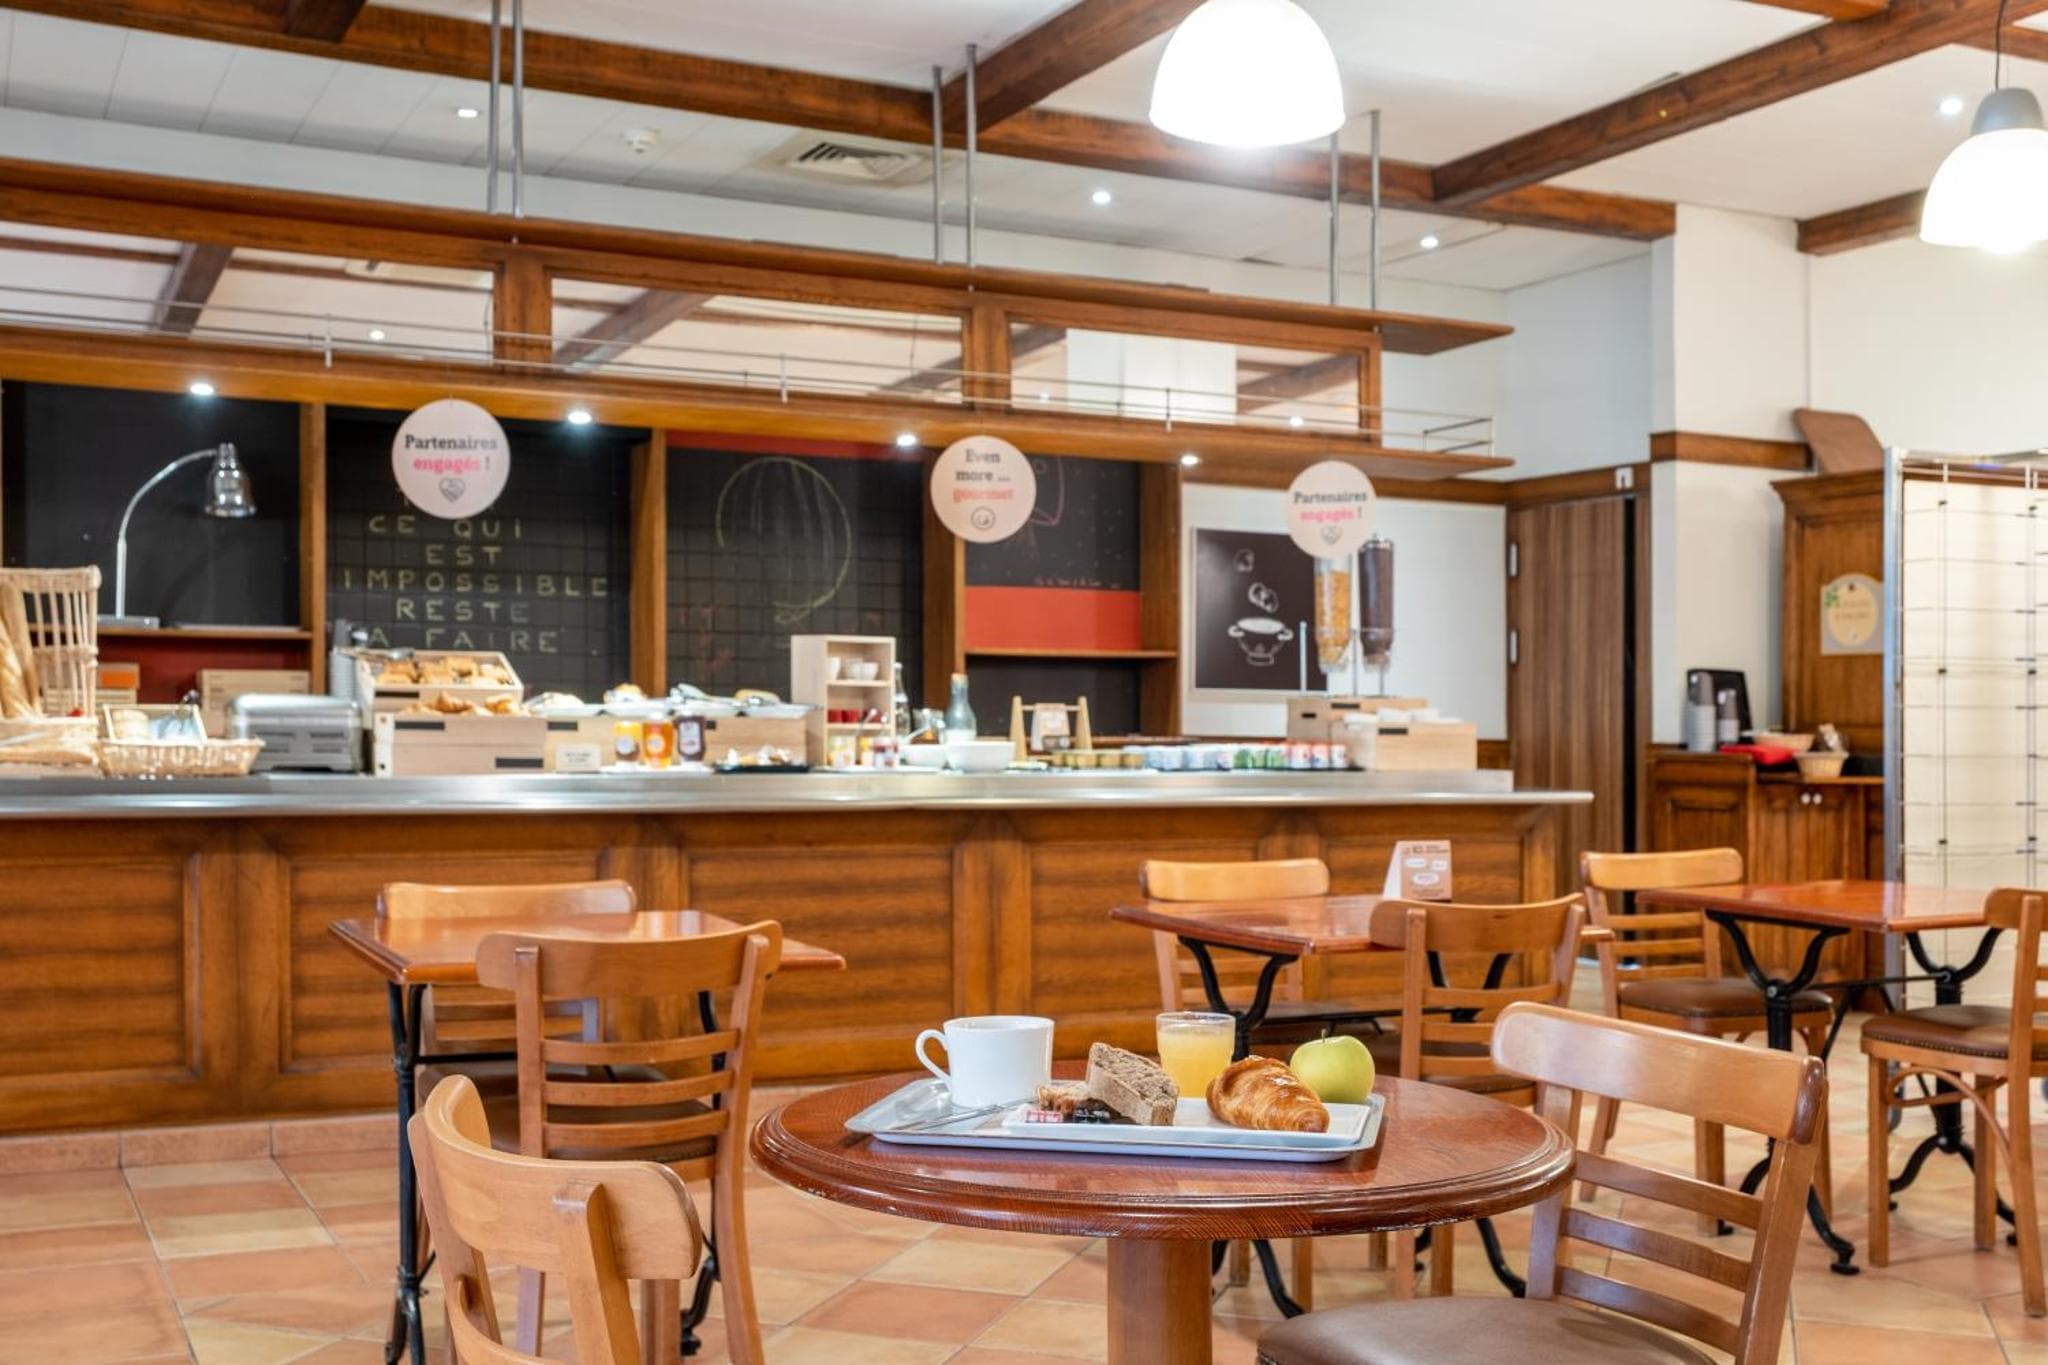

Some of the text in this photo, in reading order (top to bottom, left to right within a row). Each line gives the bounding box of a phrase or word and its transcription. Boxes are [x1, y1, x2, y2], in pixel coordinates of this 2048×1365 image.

[404, 434, 497, 450] Partenaires
[955, 471, 993, 481] more
[1294, 491, 1367, 504] Partenaires
[368, 514, 522, 540] CE QUI
[426, 545, 502, 565] EST
[344, 569, 608, 597] IMPOSSIBLE
[396, 598, 529, 623] RESTE
[424, 626, 560, 653] FAIRE
